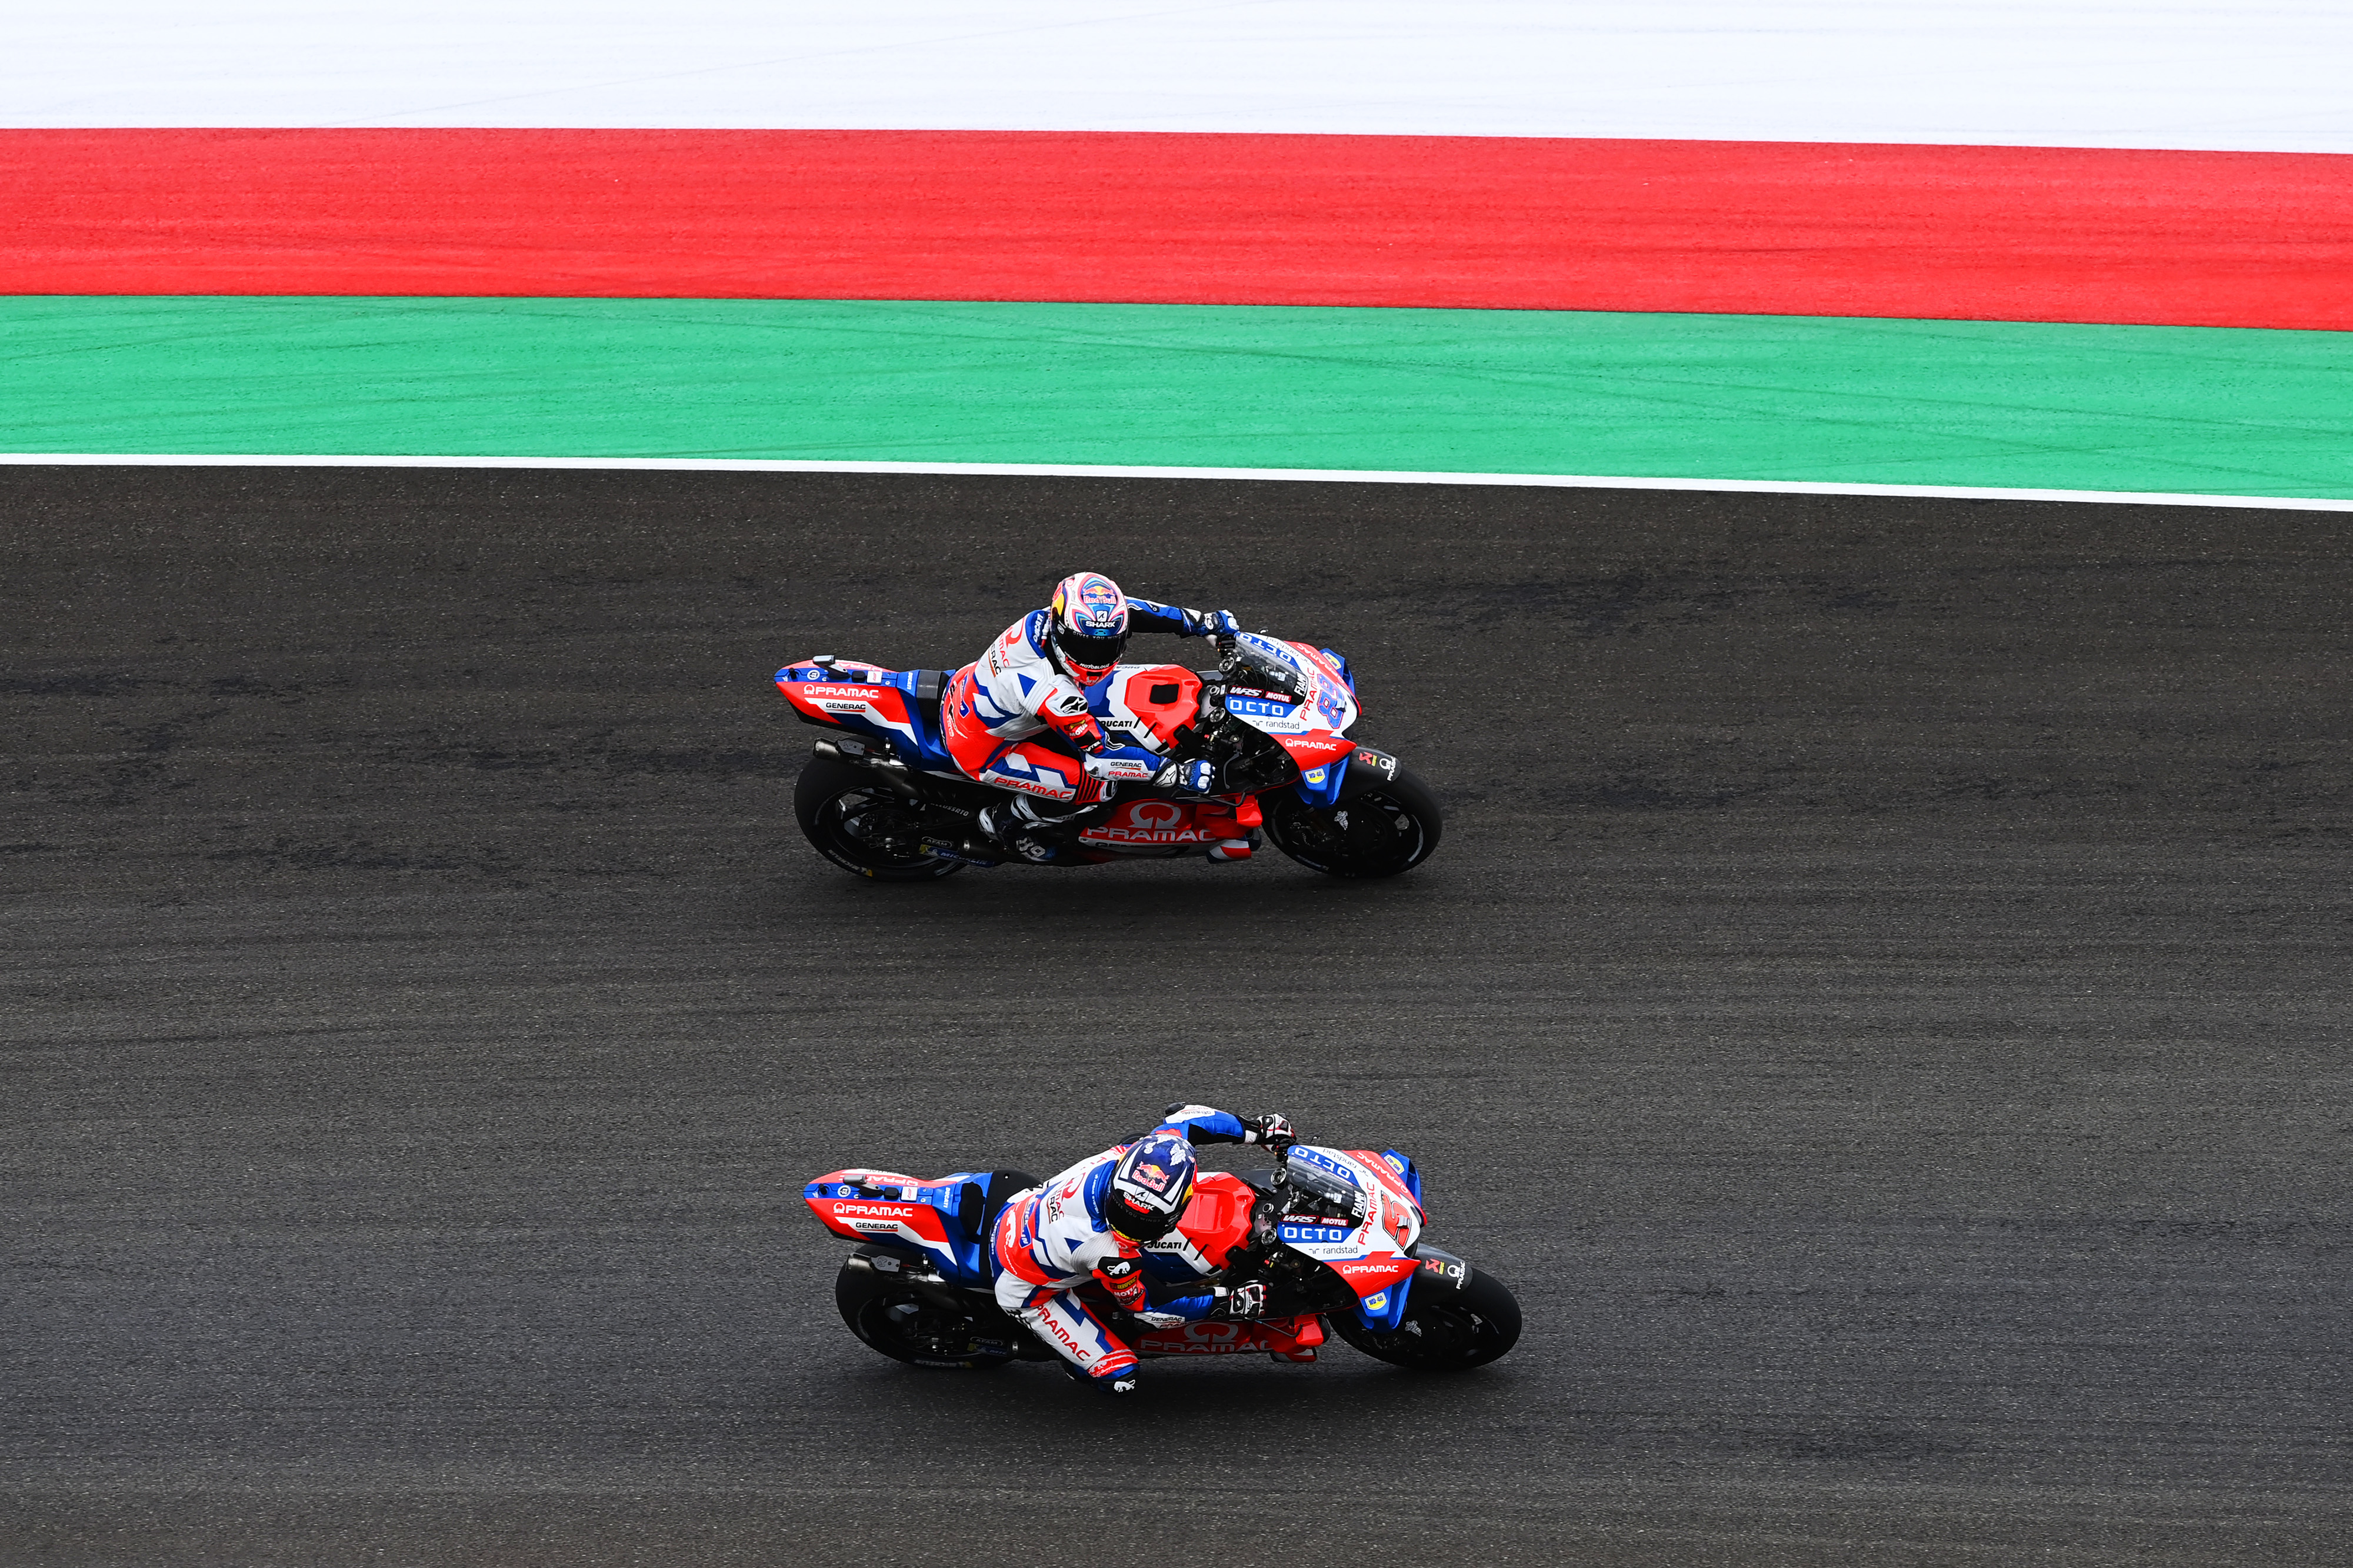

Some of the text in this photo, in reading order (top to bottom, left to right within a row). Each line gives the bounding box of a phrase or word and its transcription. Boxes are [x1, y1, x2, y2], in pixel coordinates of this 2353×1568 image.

[1083, 595, 1116, 604] Red Bull
[1033, 613, 1044, 643] DUCATI
[1072, 630, 1089, 639] GIVES
[815, 686, 879, 698] PRAMAC
[1229, 686, 1262, 697] WRS
[1266, 692, 1291, 702] MOTUL
[1299, 667, 1317, 721] PRAMAC
[1229, 699, 1284, 716] OCTO
[1069, 723, 1088, 736] MOTUL
[1266, 720, 1299, 730] randstad
[1294, 740, 1337, 751] PRAMAC
[994, 777, 1072, 799] PRAMAC
[1087, 826, 1217, 842] PRAMAC
[1131, 1169, 1166, 1193] Red Bull
[1122, 1191, 1155, 1211] SHARK
[845, 1205, 913, 1217] PRAMAC
[1125, 1209, 1136, 1218] YOU
[1357, 1182, 1377, 1246] PRAMAC
[1282, 1215, 1317, 1223] WRS
[1321, 1217, 1348, 1226] MOTUL
[1284, 1227, 1342, 1240] OCTO
[1323, 1245, 1358, 1254] randstad
[1352, 1265, 1399, 1273] PRAMAC
[1456, 1261, 1466, 1290] PRAMAC
[1368, 1295, 1384, 1306] WD-40
[1037, 1305, 1091, 1362] PRAMAC
[1141, 1339, 1275, 1352] PRAMAC
